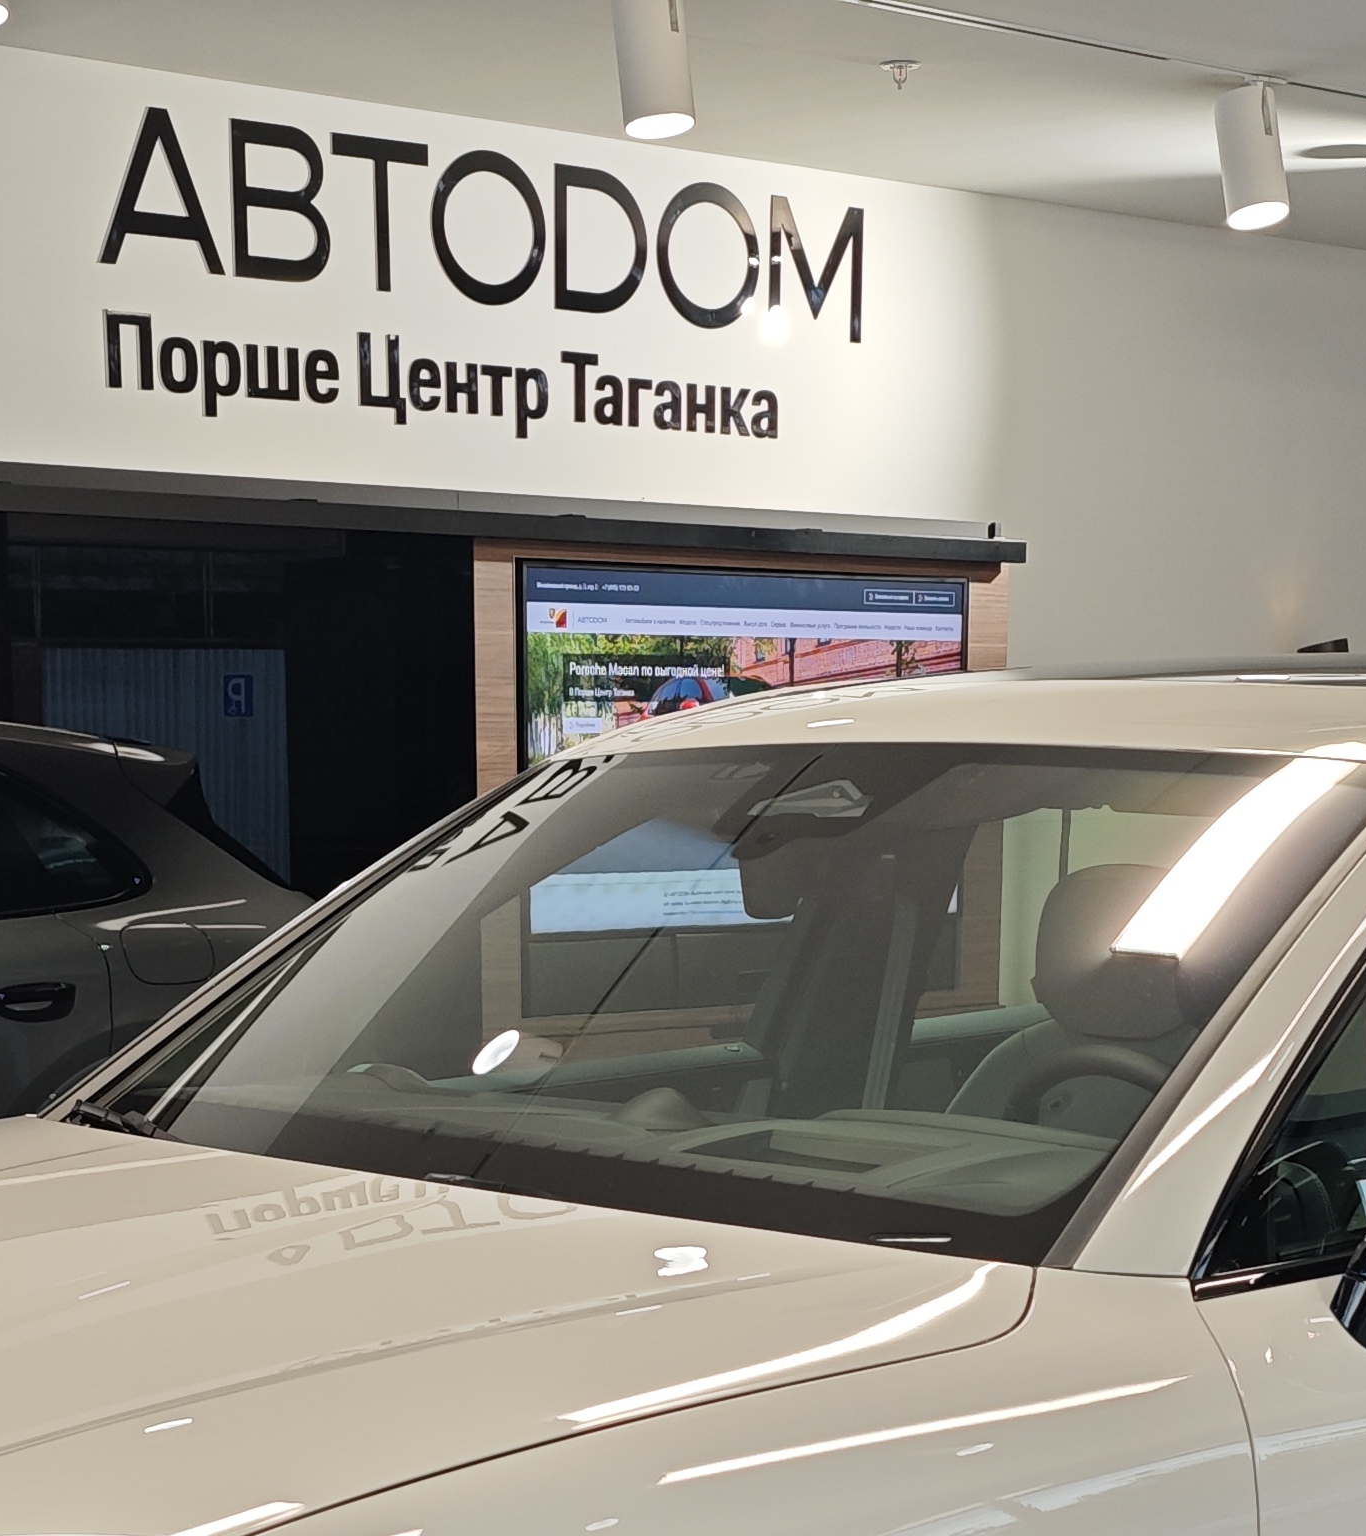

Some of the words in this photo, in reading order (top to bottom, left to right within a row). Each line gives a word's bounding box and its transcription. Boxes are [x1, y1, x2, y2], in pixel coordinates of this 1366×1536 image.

[102, 308, 340, 417] Порше
[357, 331, 549, 438] Центр
[561, 350, 780, 439] Таганка
